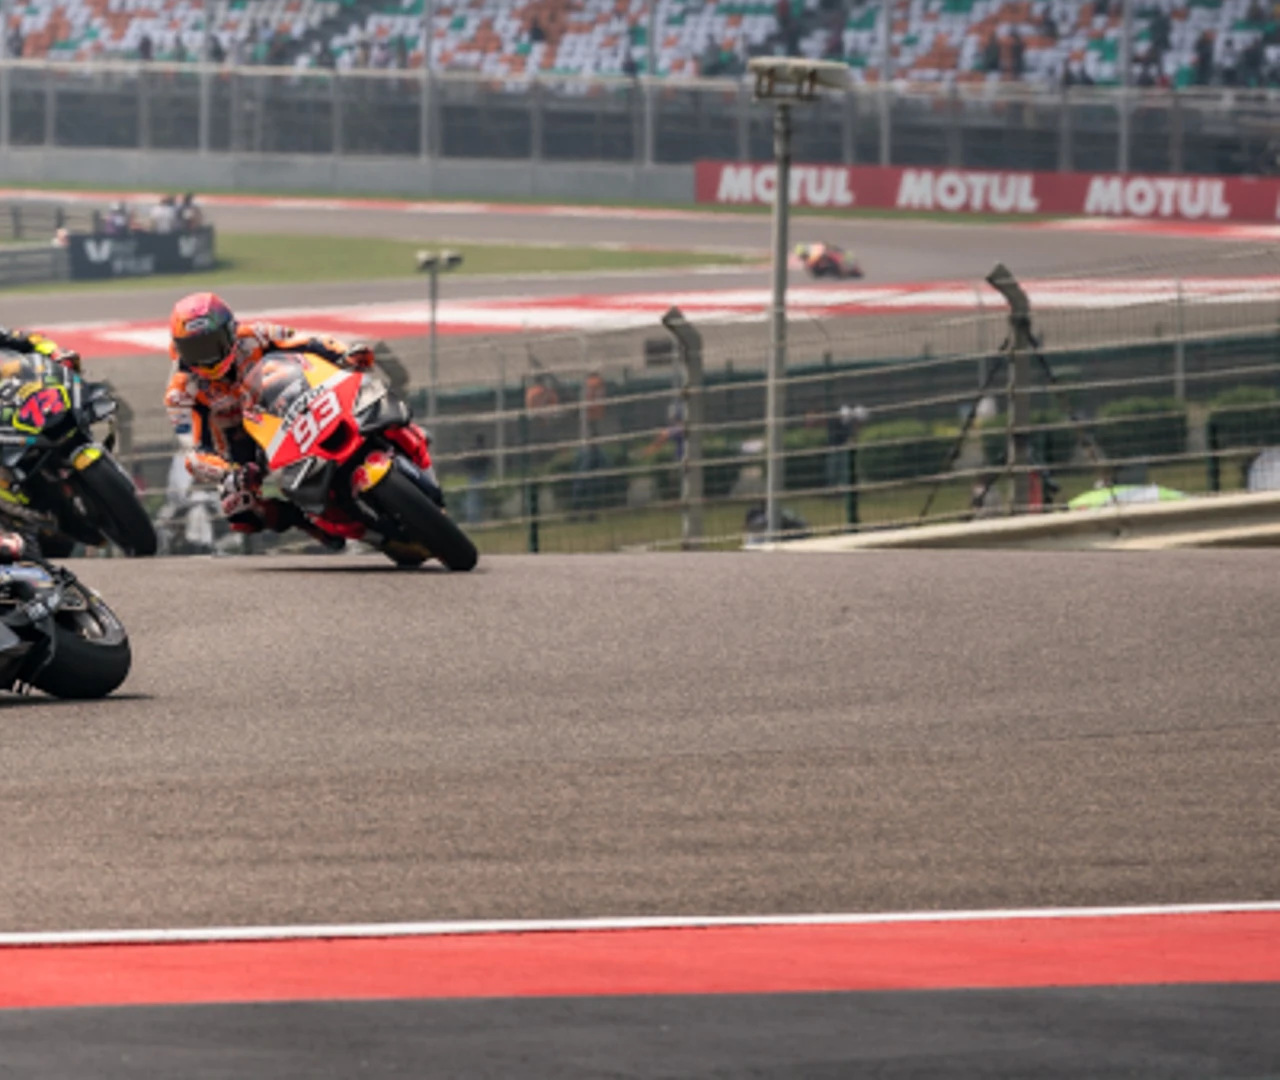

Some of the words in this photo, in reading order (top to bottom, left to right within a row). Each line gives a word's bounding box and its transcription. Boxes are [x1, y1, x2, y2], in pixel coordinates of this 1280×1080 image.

[717, 163, 855, 206] MOTUL
[896, 167, 1039, 211] MOTUL
[1084, 175, 1231, 219] MOTUL
[292, 389, 343, 454] 93
